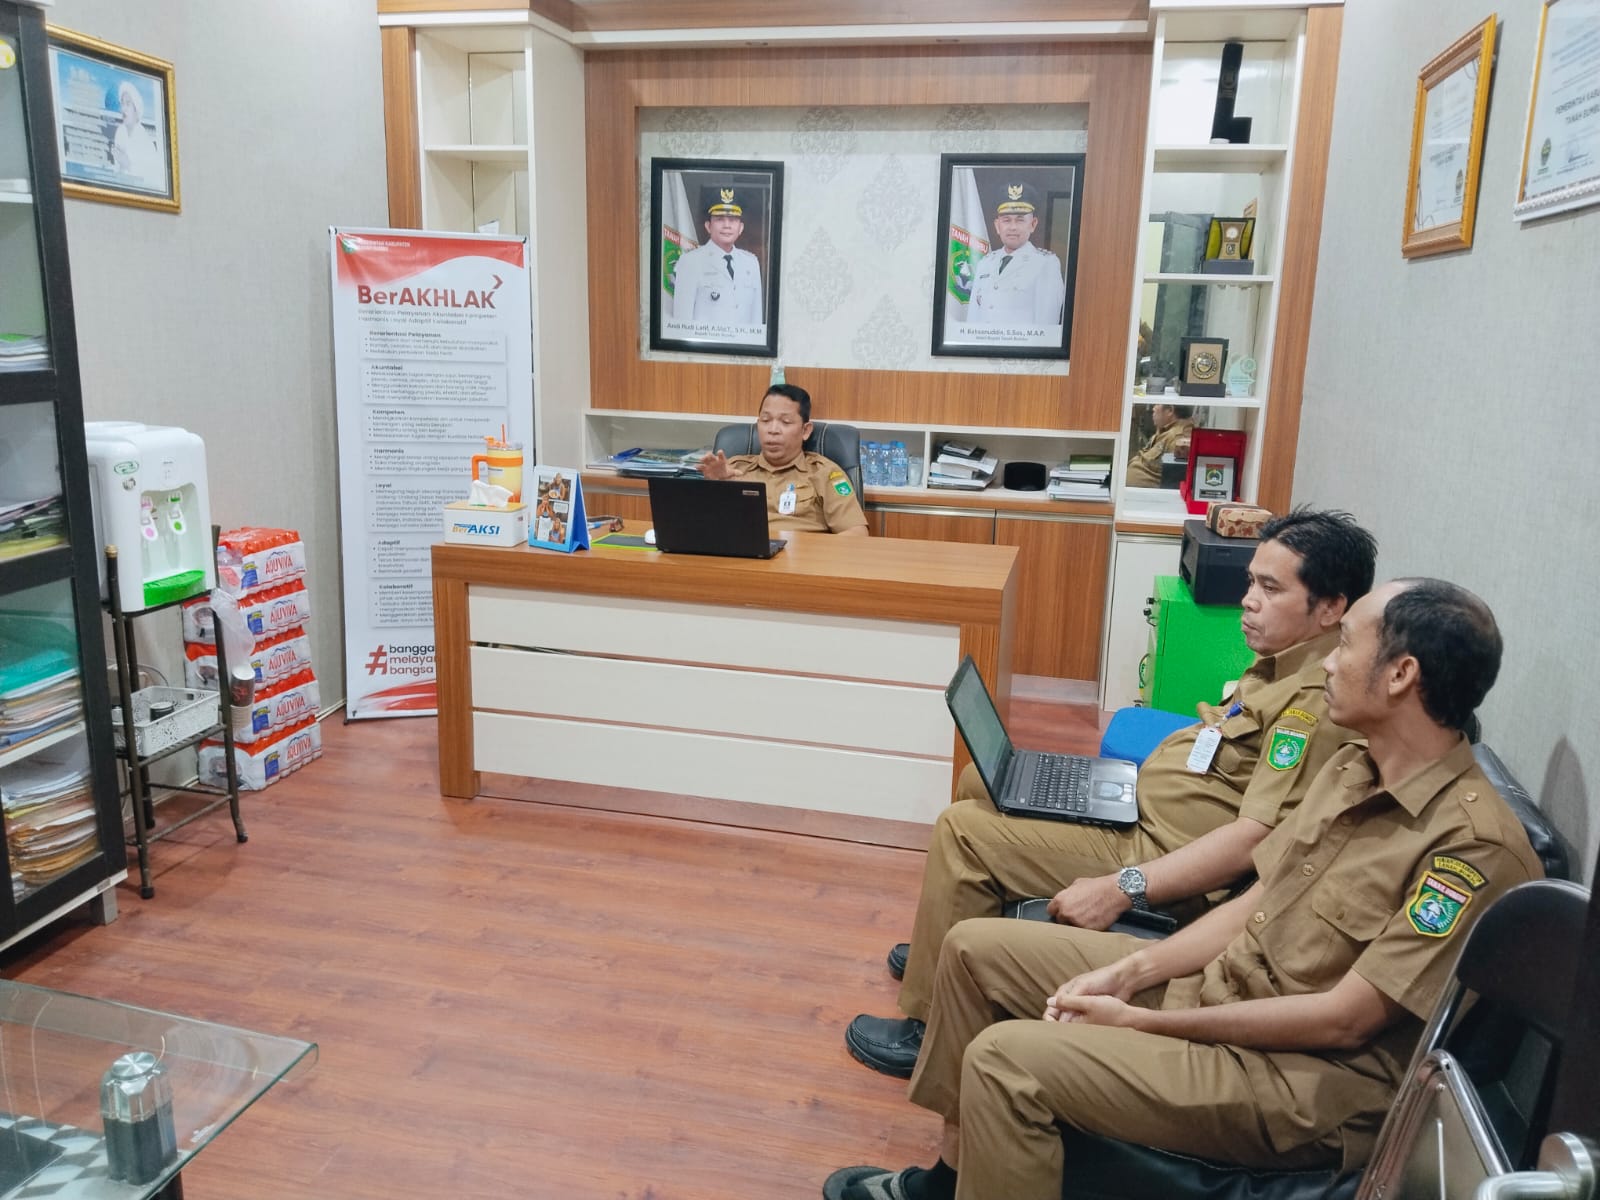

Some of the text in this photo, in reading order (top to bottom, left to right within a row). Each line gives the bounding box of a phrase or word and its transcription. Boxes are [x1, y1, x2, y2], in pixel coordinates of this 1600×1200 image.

[358, 284, 496, 309] BerAKHLAK
[390, 644, 434, 656] bangga
[390, 656, 436, 666] melaya
[390, 666, 434, 676] bangsa
